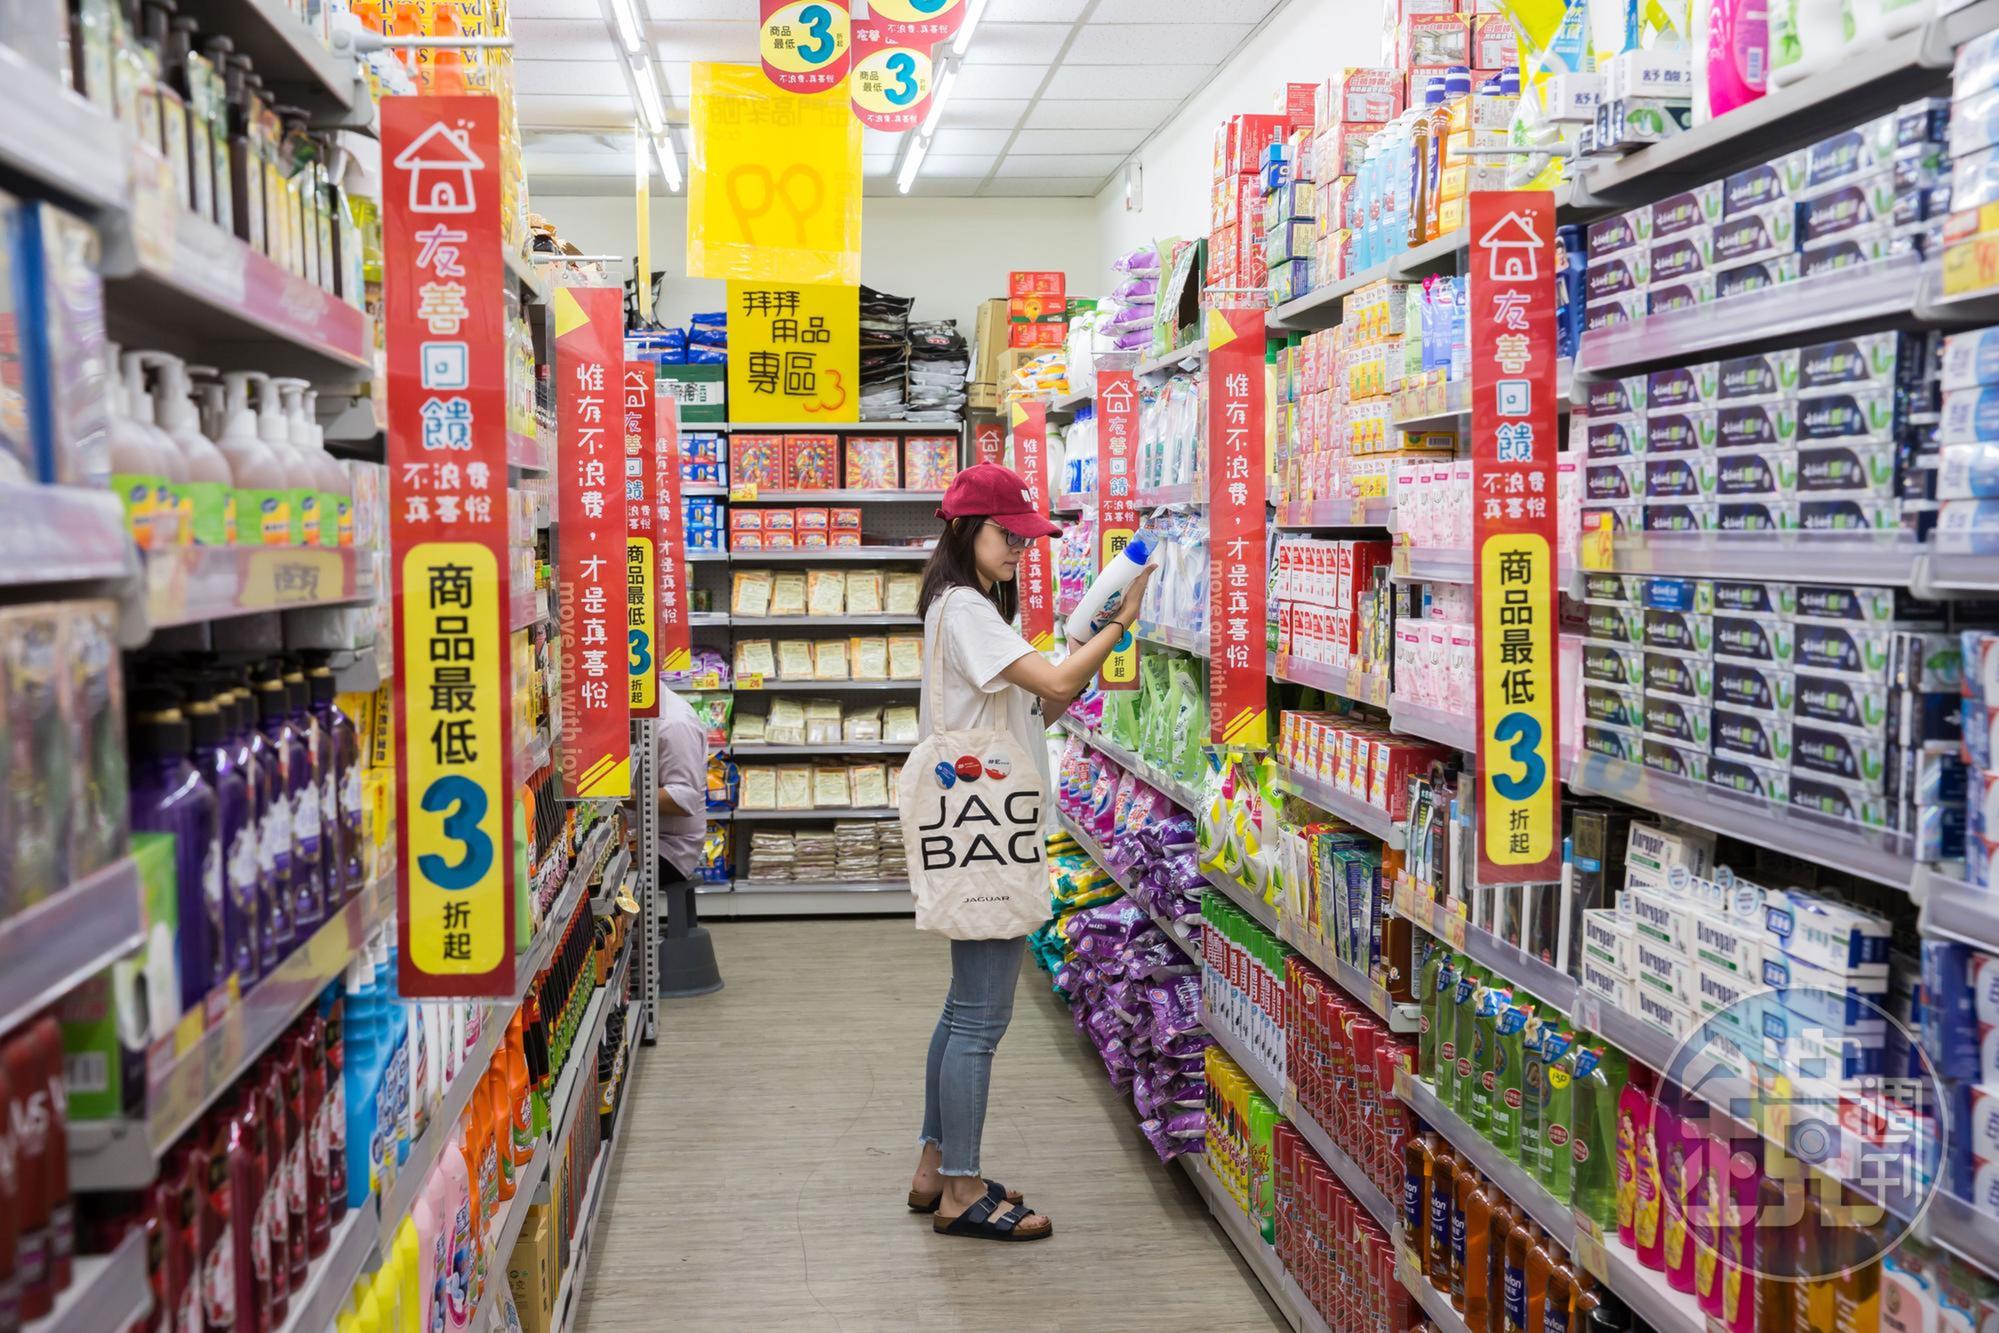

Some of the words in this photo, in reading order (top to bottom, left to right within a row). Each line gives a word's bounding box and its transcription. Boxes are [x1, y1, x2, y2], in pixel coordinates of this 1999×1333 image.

[769, 26, 792, 37] 商品
[797, 5, 835, 64] 3
[773, 38, 796, 50] 最低
[859, 71, 879, 81] 商品
[863, 82, 882, 92] 最低
[884, 52, 918, 105] 3
[743, 291, 800, 317] 拜拜
[415, 223, 474, 452] 友善回饋
[773, 316, 830, 344] 用品
[1493, 289, 1533, 463] 友善回饋
[402, 461, 491, 490] 不浪費
[1482, 471, 1546, 494] 不浪費
[628, 505, 651, 518] 浪費
[1482, 497, 1547, 520] 真喜悅
[628, 519, 651, 530] 喜悅
[919, 791, 1040, 832] JAG
[921, 830, 1041, 871] BAG
[962, 895, 1010, 904] JAGUAR
